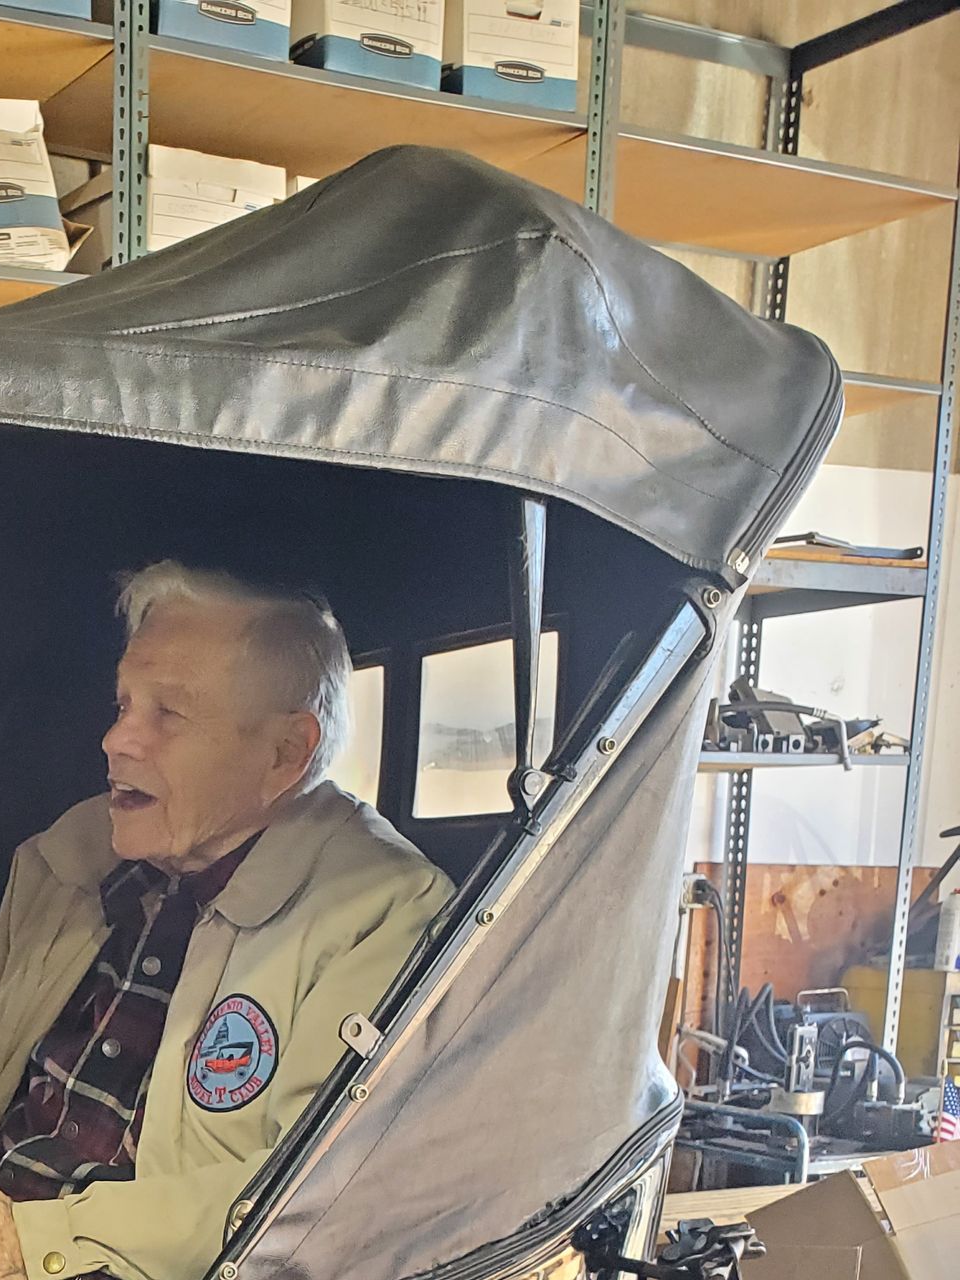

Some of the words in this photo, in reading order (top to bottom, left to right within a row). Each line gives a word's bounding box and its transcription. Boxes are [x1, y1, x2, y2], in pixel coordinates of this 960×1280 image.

[246, 1005, 273, 1057] VALLEY
[190, 1075, 213, 1105] MODEL
[215, 1086, 227, 1104] T
[230, 1075, 263, 1104] CLUB
